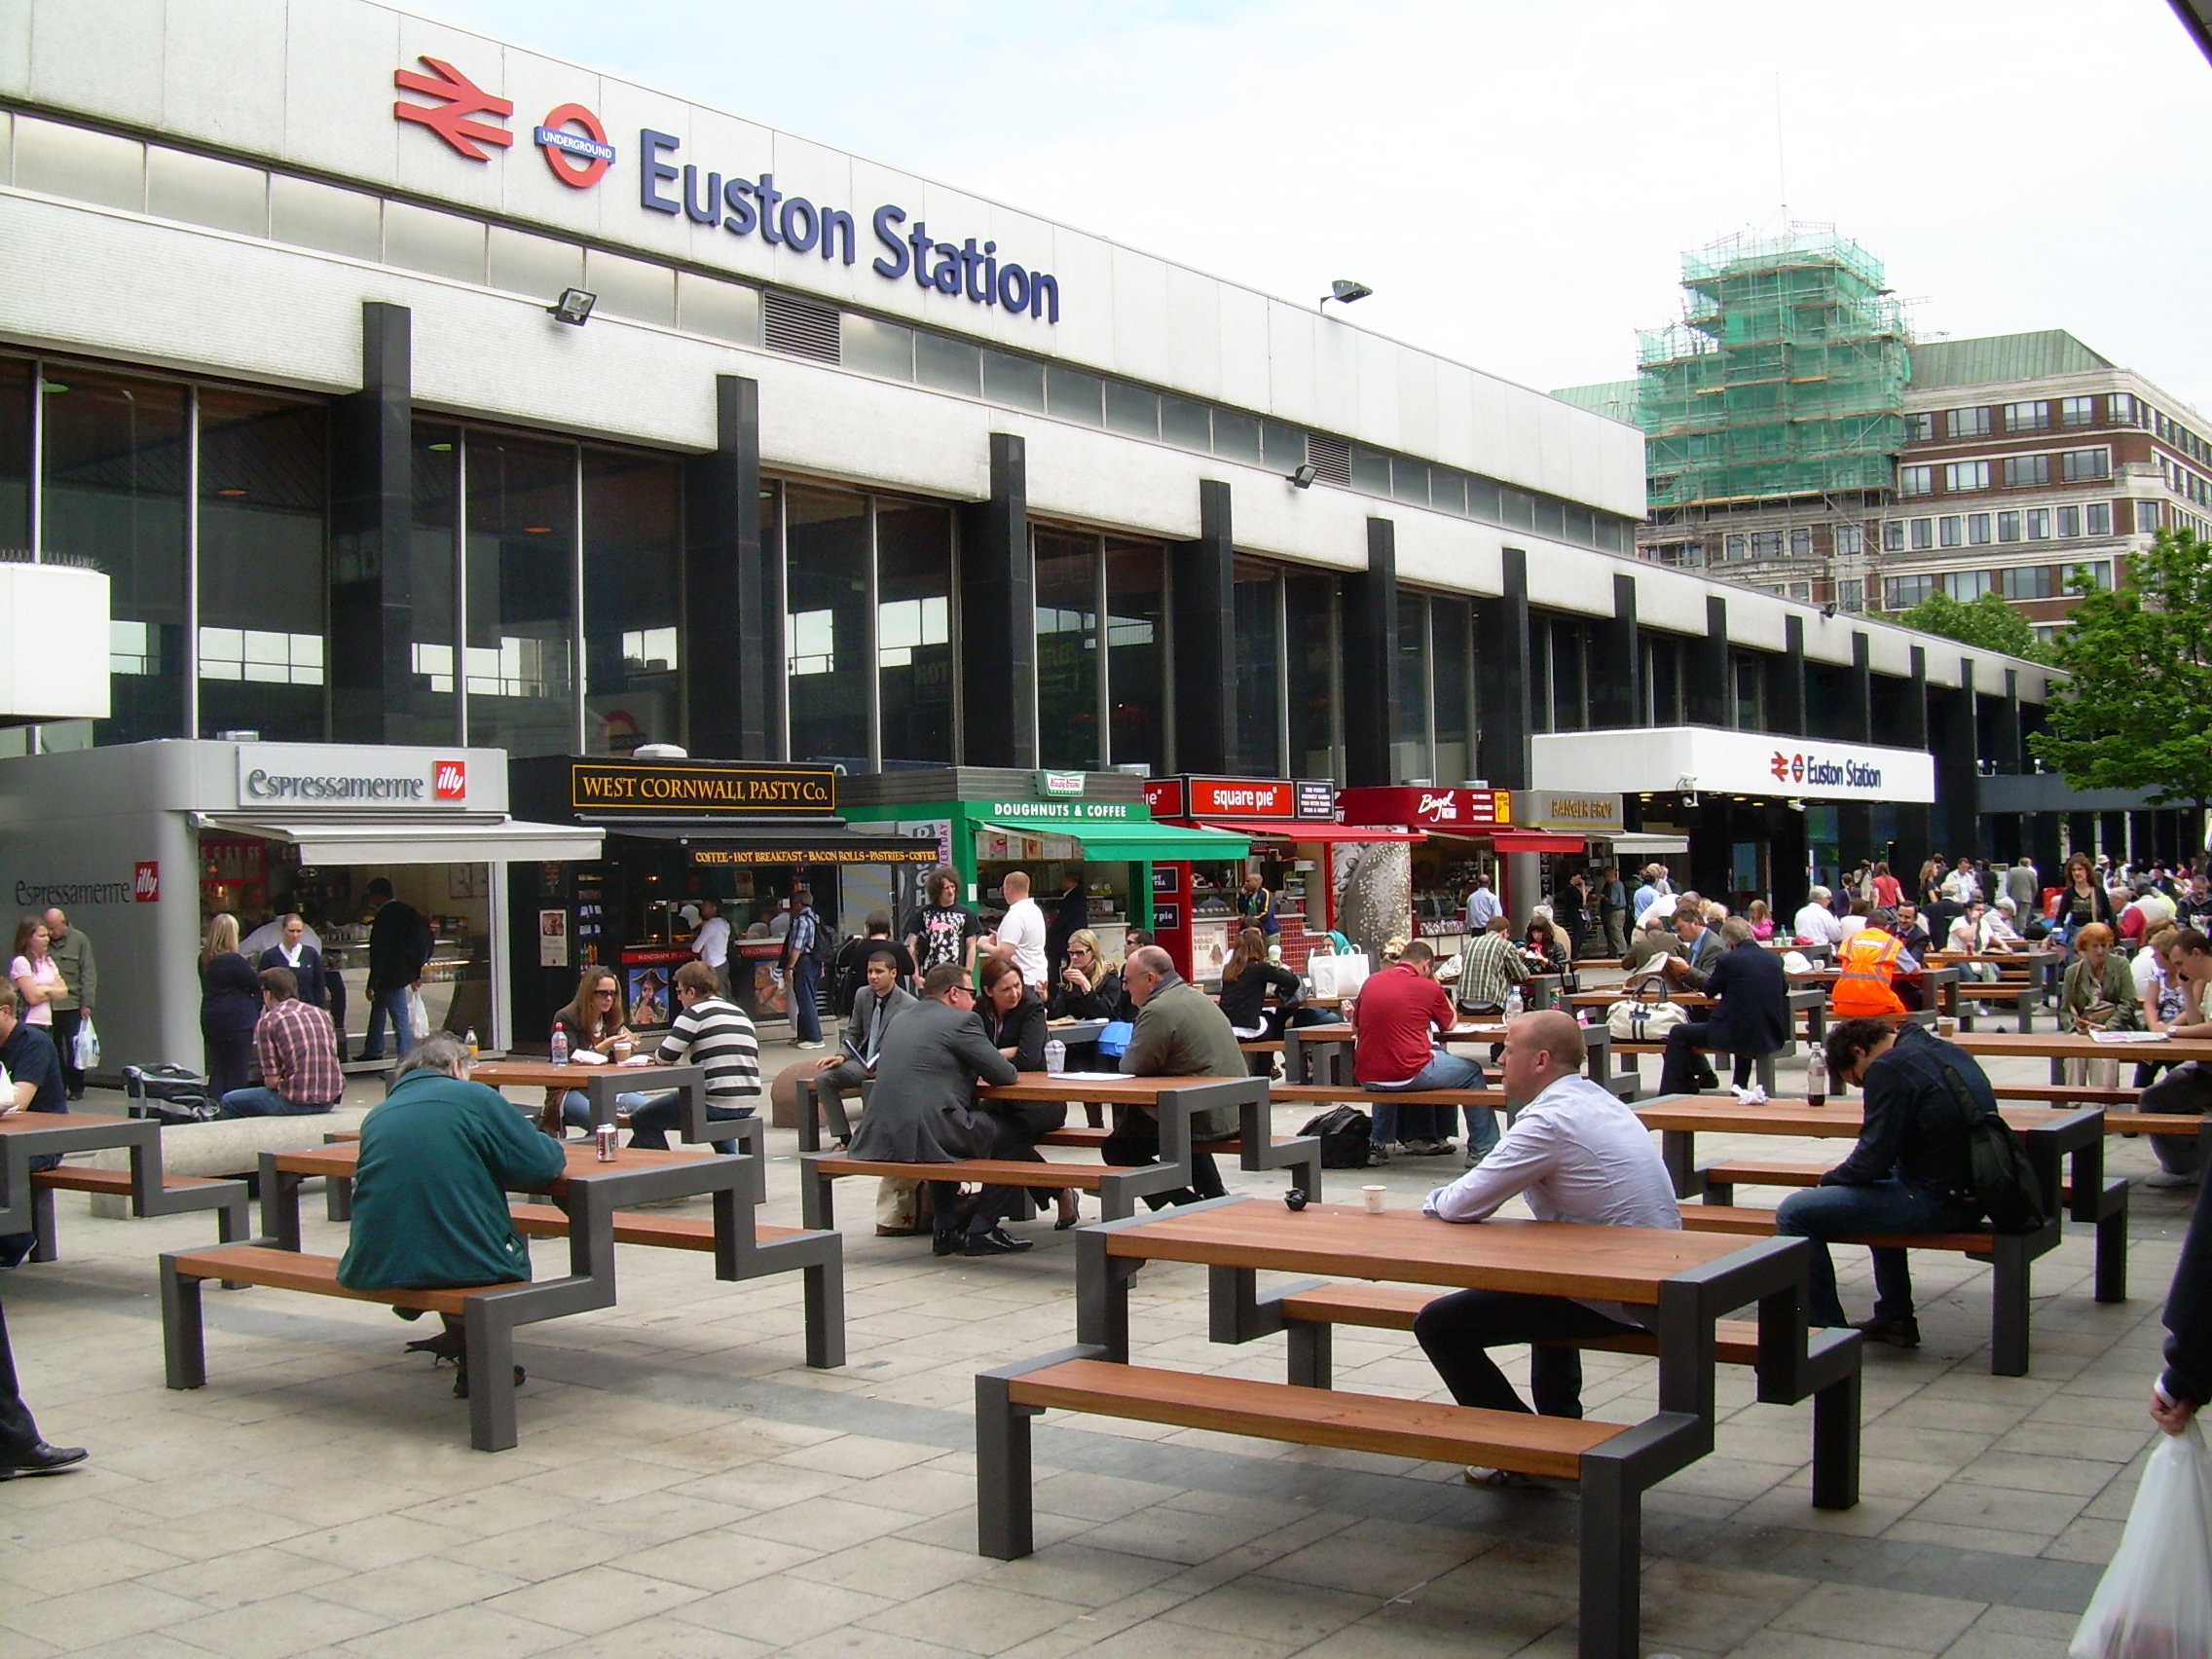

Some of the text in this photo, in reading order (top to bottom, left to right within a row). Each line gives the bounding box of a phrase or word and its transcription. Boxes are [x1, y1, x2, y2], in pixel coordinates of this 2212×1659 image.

[542, 130, 612, 159] UNDERGROUND
[640, 128, 1059, 324] Euston Station
[248, 766, 463, 800] espressamente illy
[1807, 755, 1882, 789] Euston Station
[583, 776, 637, 798] WEST
[641, 778, 746, 801] CORNWALL
[749, 780, 801, 801] PASTY
[1145, 792, 1158, 806] ie
[1213, 790, 1254, 811] square
[1256, 790, 1274, 812] pie
[994, 803, 1126, 818] DOUGHNUTS & COFFEE
[1418, 790, 1456, 823] Bagel
[695, 850, 938, 863] COFFEE HOT BREAKFAST BACON ROLLS PASTRIES COFFEE
[940, 824, 948, 868] VERYDAY
[16, 867, 158, 906] espressamente illy
[1159, 910, 1173, 922] pie
